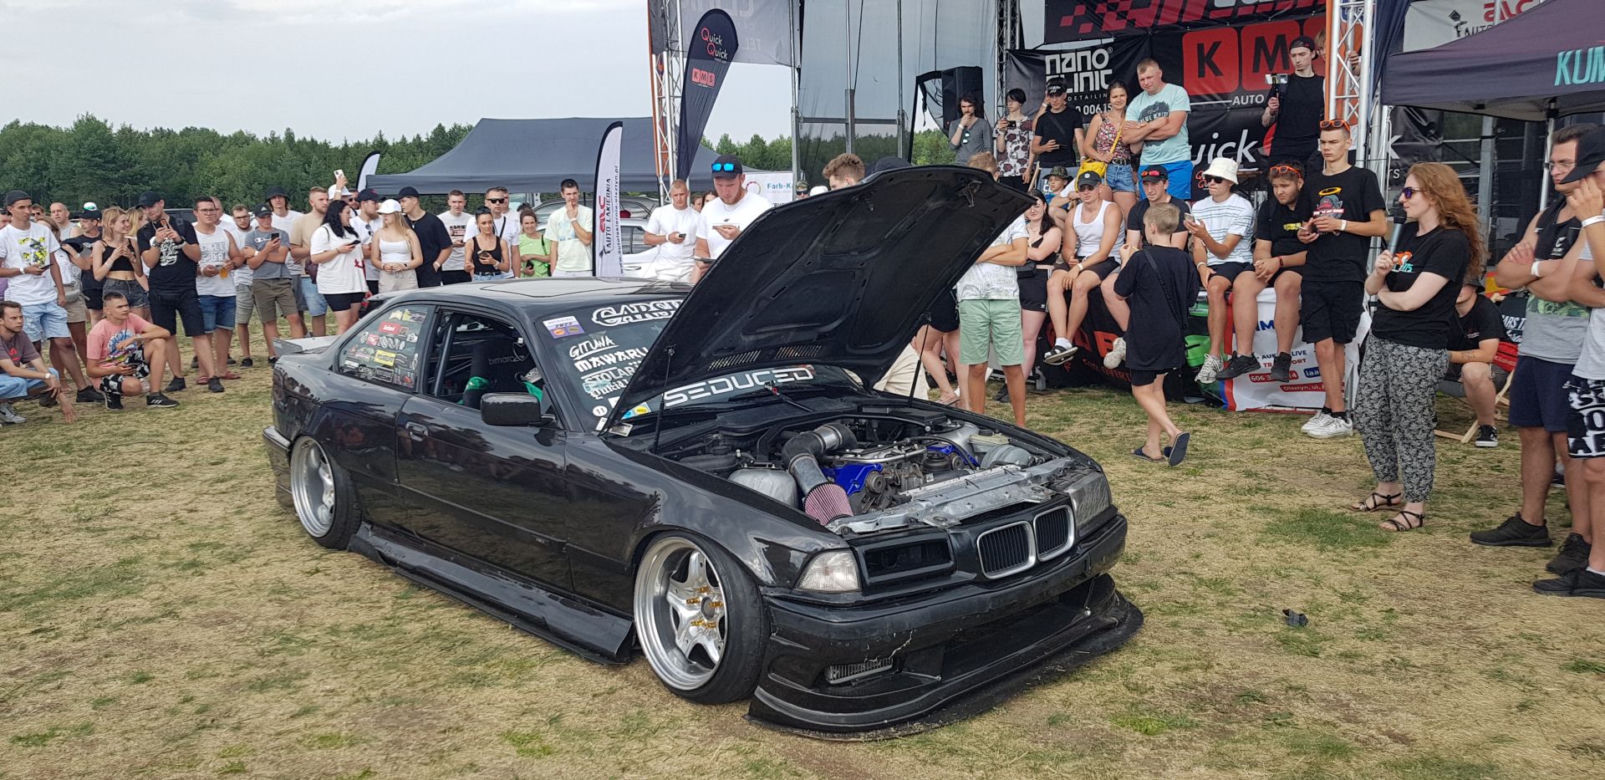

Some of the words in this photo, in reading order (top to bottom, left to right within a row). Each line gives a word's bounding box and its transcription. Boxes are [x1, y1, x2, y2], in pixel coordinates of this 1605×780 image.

[701, 27, 723, 46] Quick
[707, 42, 728, 60] Quick
[1232, 93, 1264, 106] AUTO
[663, 364, 814, 407] SEDUCED
